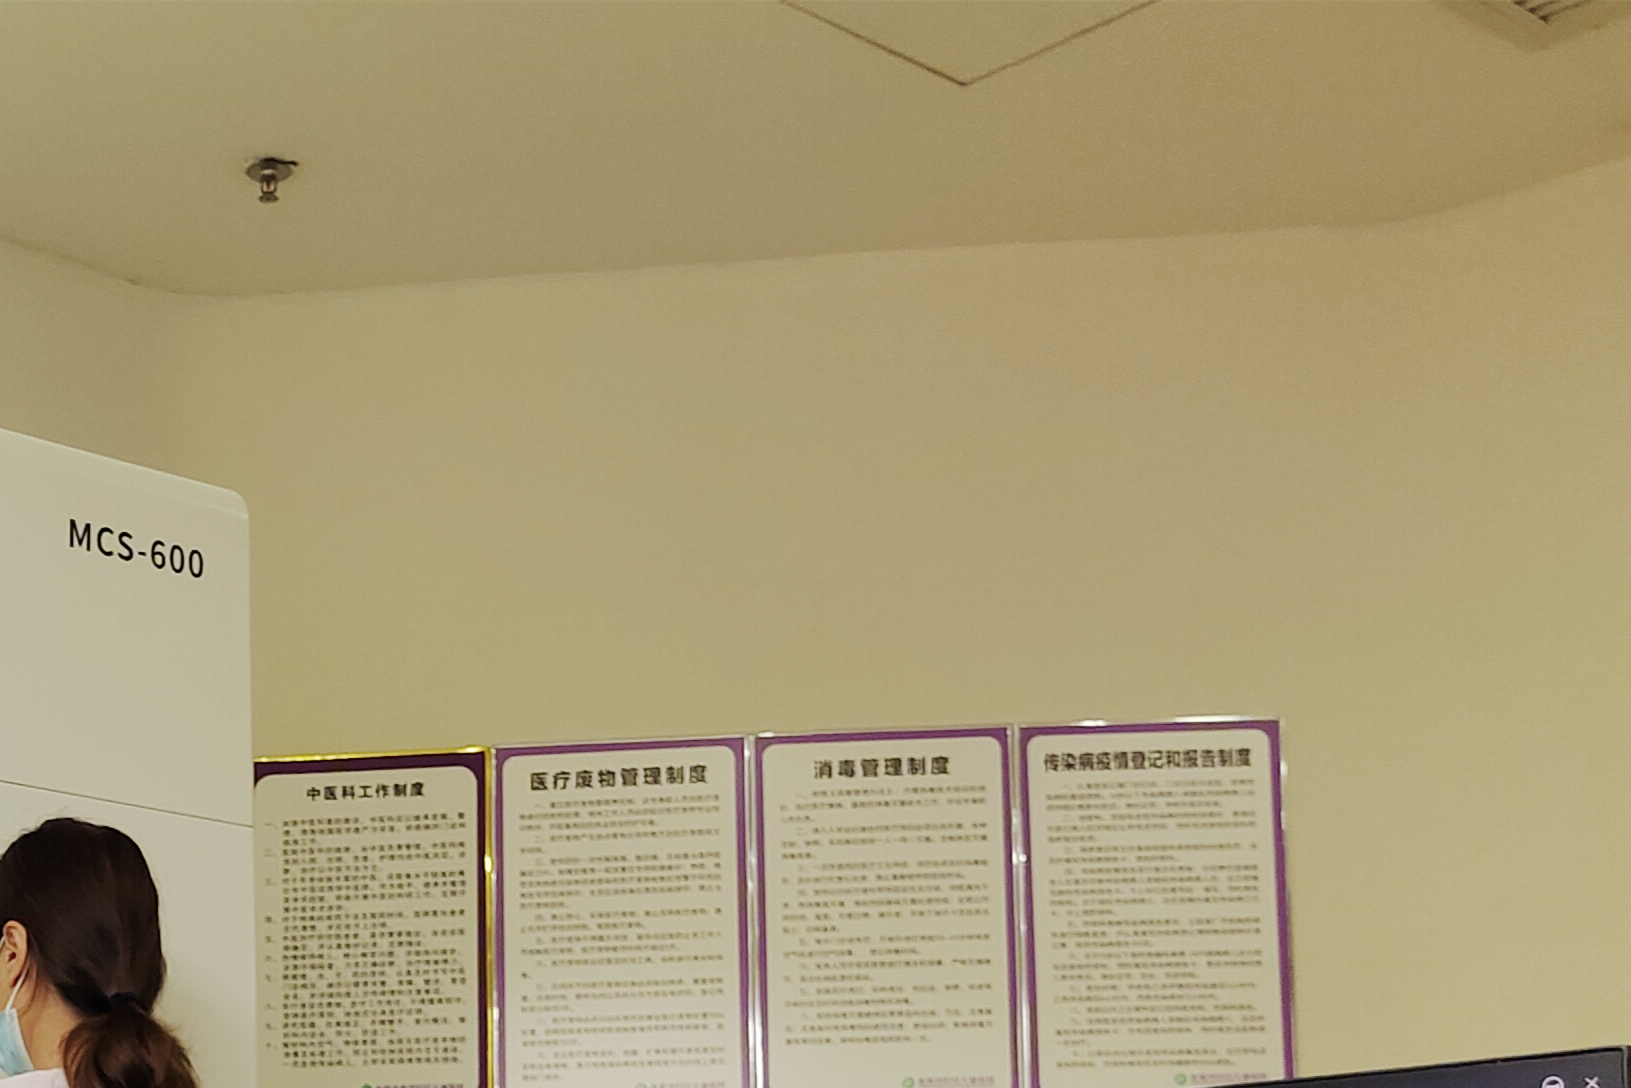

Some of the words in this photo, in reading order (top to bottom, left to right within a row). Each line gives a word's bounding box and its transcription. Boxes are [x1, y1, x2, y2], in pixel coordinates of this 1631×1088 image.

[69, 518, 204, 578] MCS-600
[814, 756, 949, 779] 消毒管理制度
[1044, 748, 1251, 772] 传染病疫情登记和报告制度
[530, 765, 707, 791] 医疗废物管理制度
[307, 782, 424, 801] 中医科工作制度
